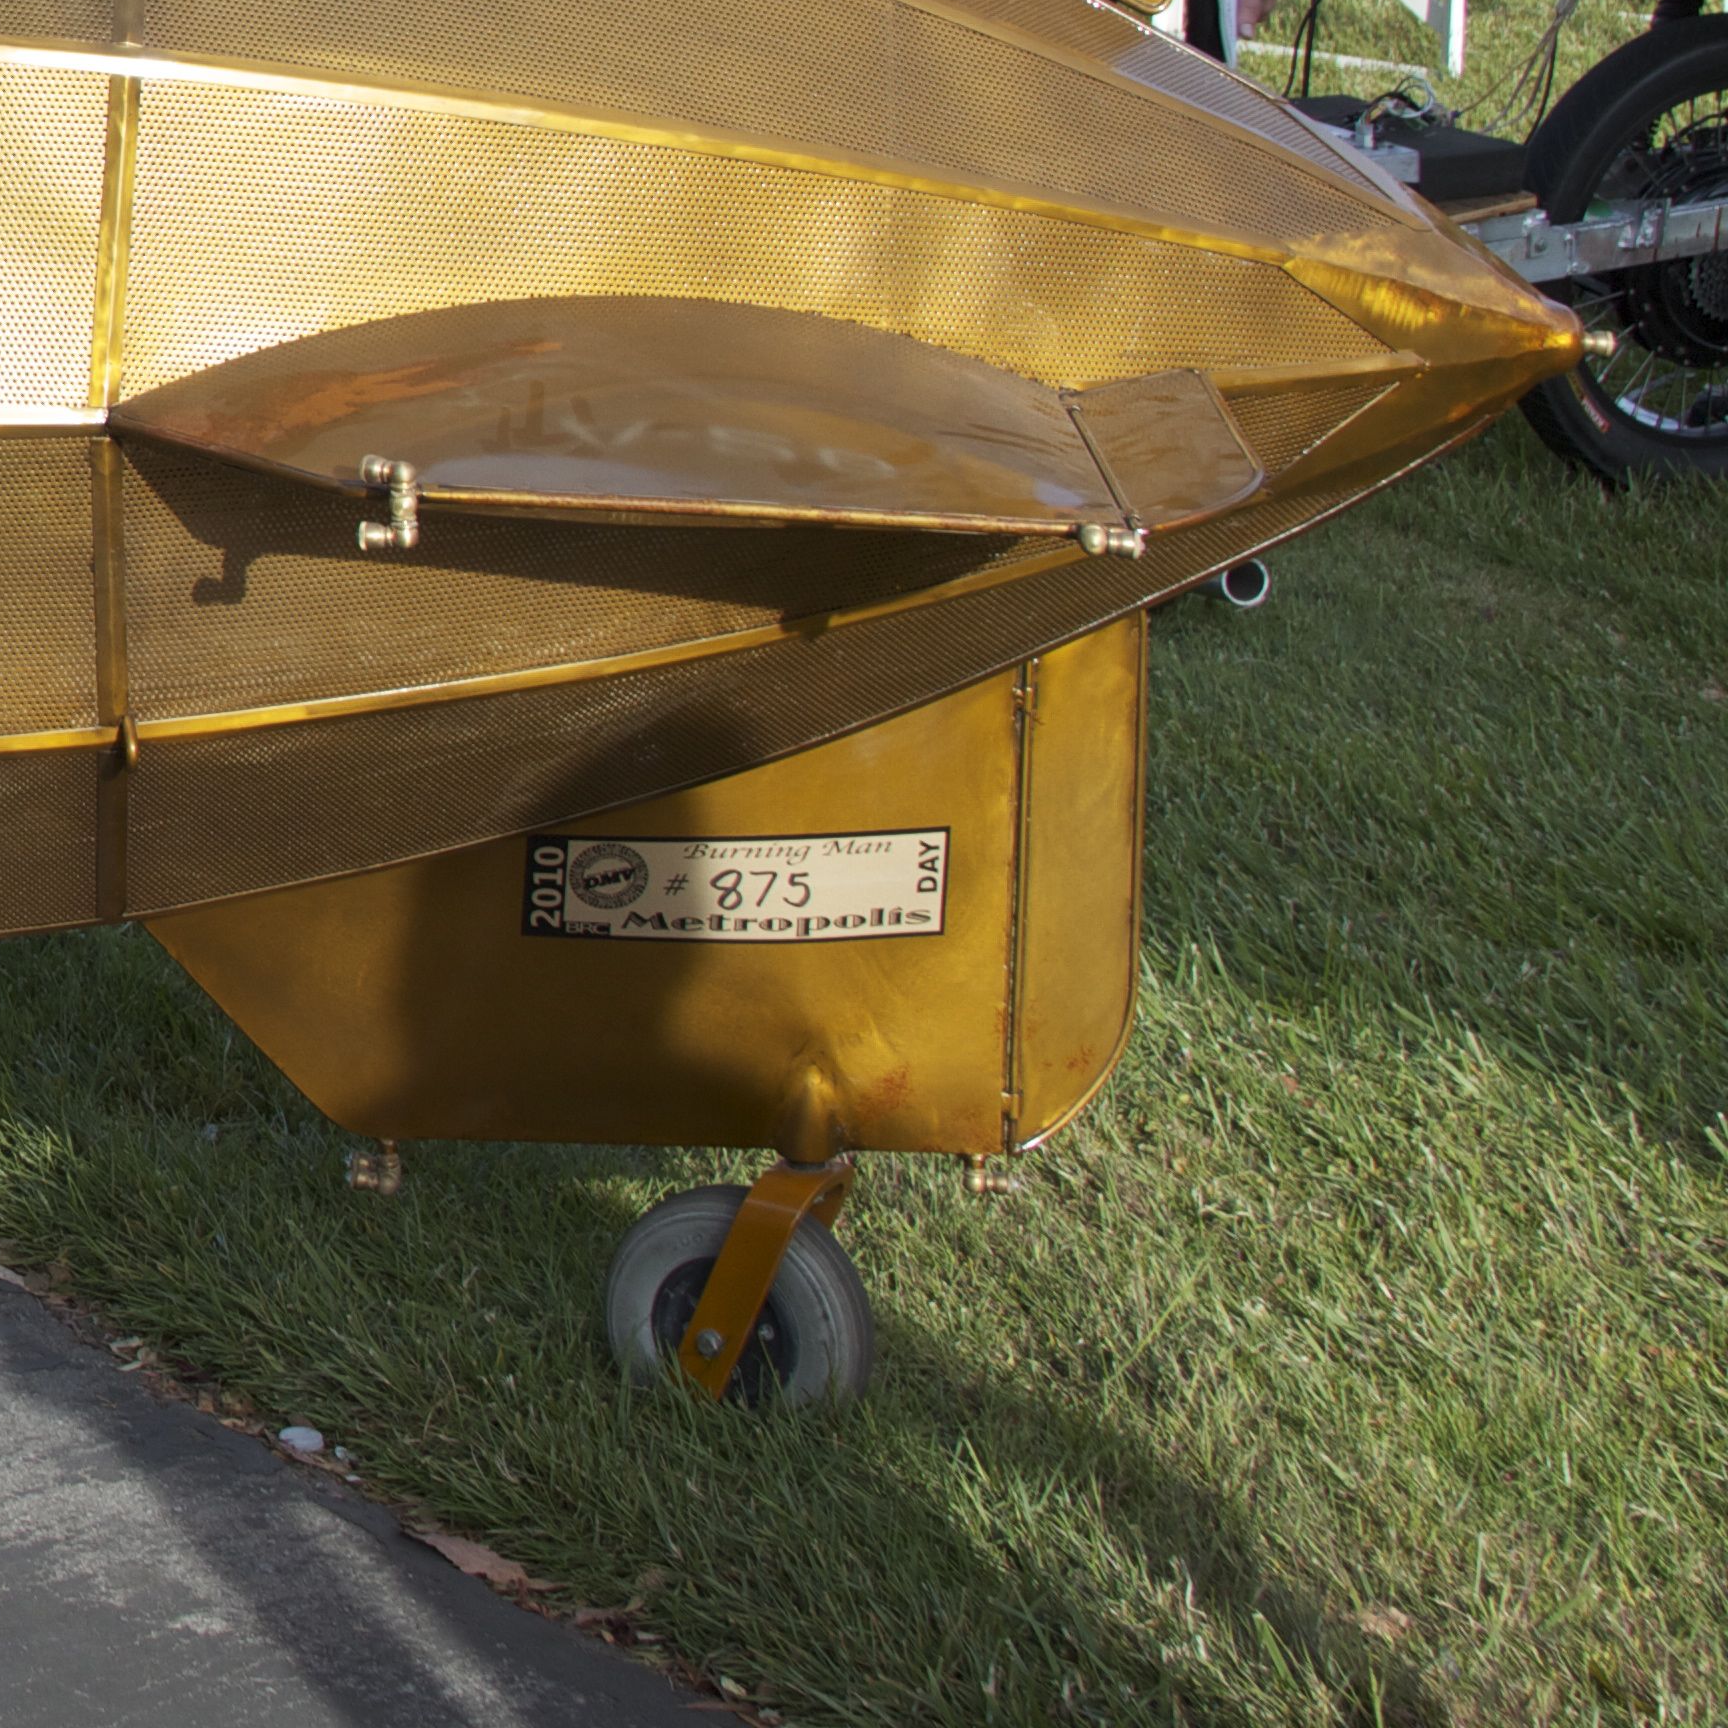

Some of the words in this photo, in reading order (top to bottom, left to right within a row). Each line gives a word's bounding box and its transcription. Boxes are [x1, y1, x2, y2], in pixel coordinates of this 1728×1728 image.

[683, 842, 810, 866] Burning
[821, 838, 893, 856] Man
[916, 840, 940, 893] DAY
[530, 845, 565, 929] 2010
[709, 869, 811, 911] 875
[621, 907, 933, 937] Metropolis
